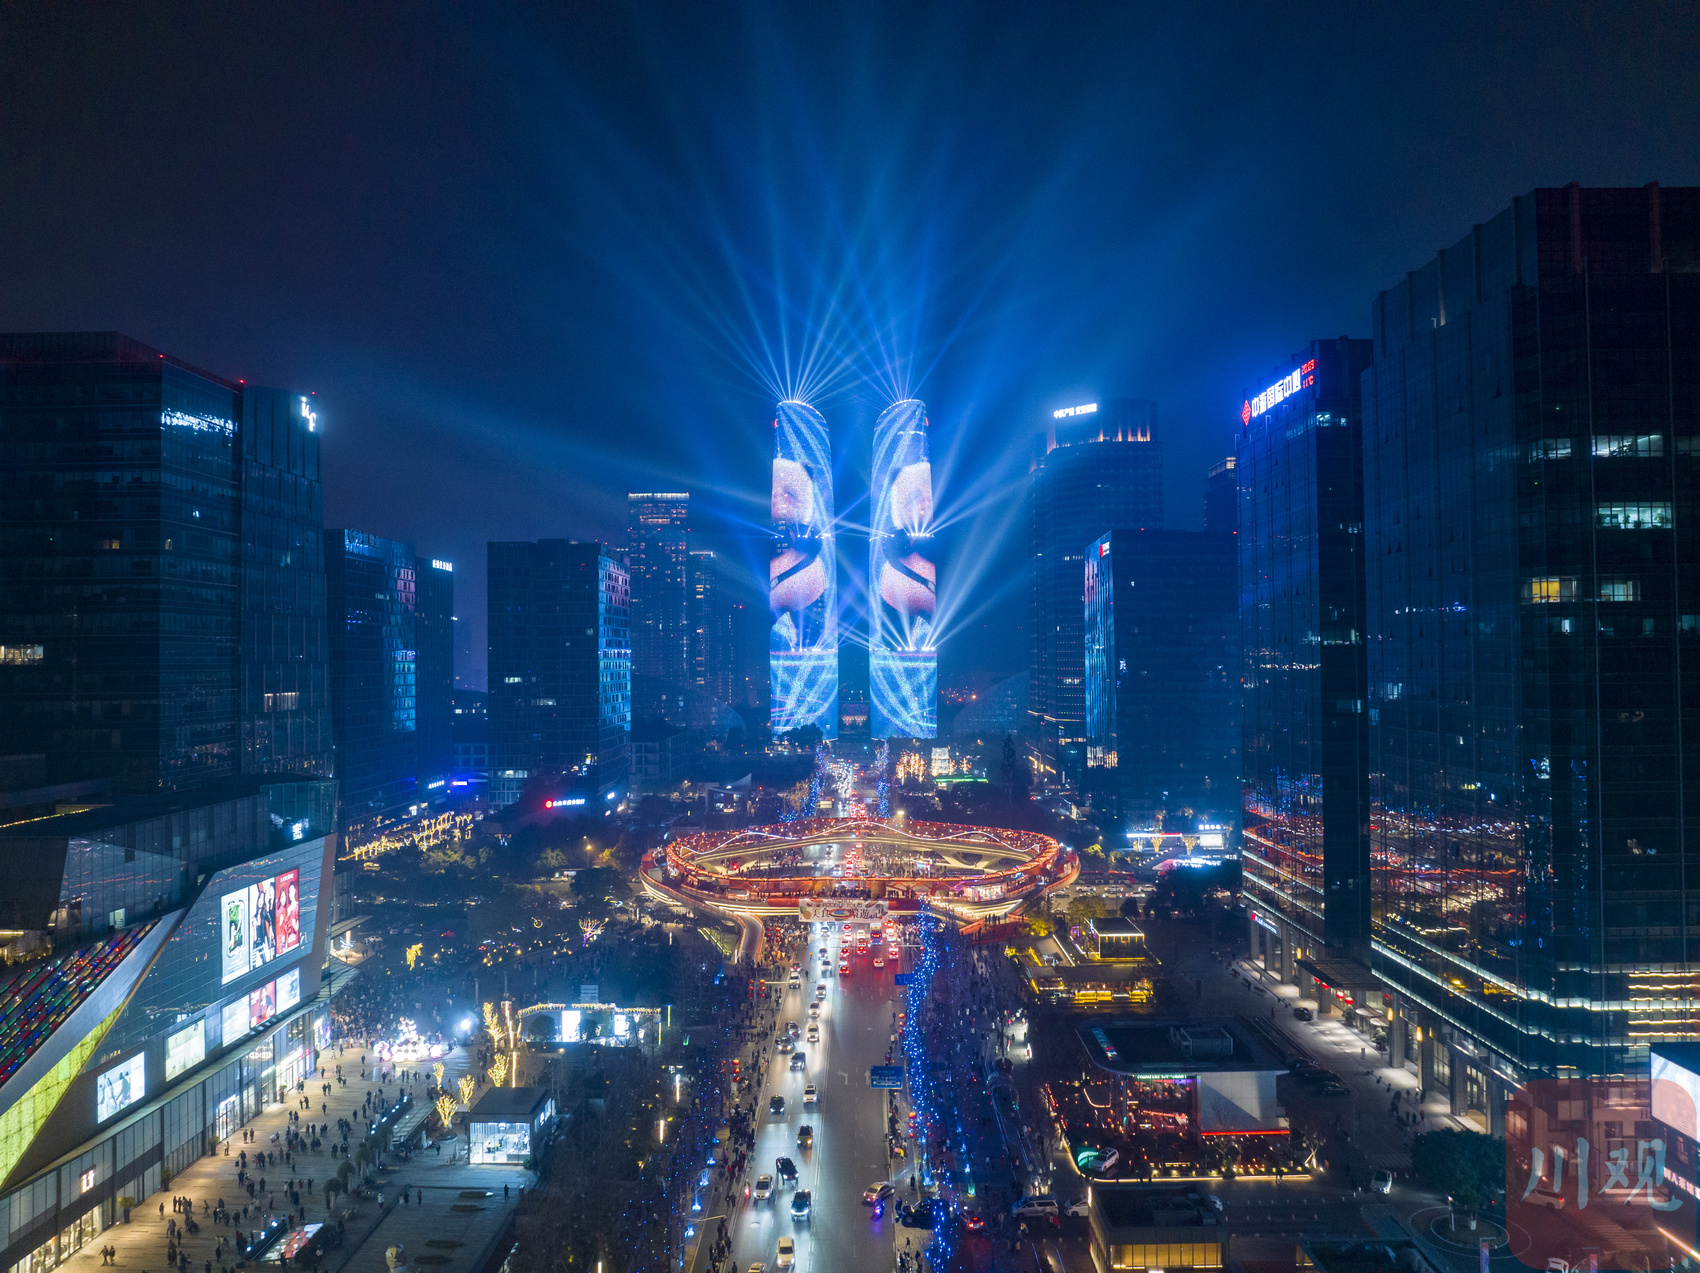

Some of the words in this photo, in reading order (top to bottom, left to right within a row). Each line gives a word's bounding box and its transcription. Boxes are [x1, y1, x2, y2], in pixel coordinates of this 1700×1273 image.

[1251, 368, 1302, 418] 中海国际中心
